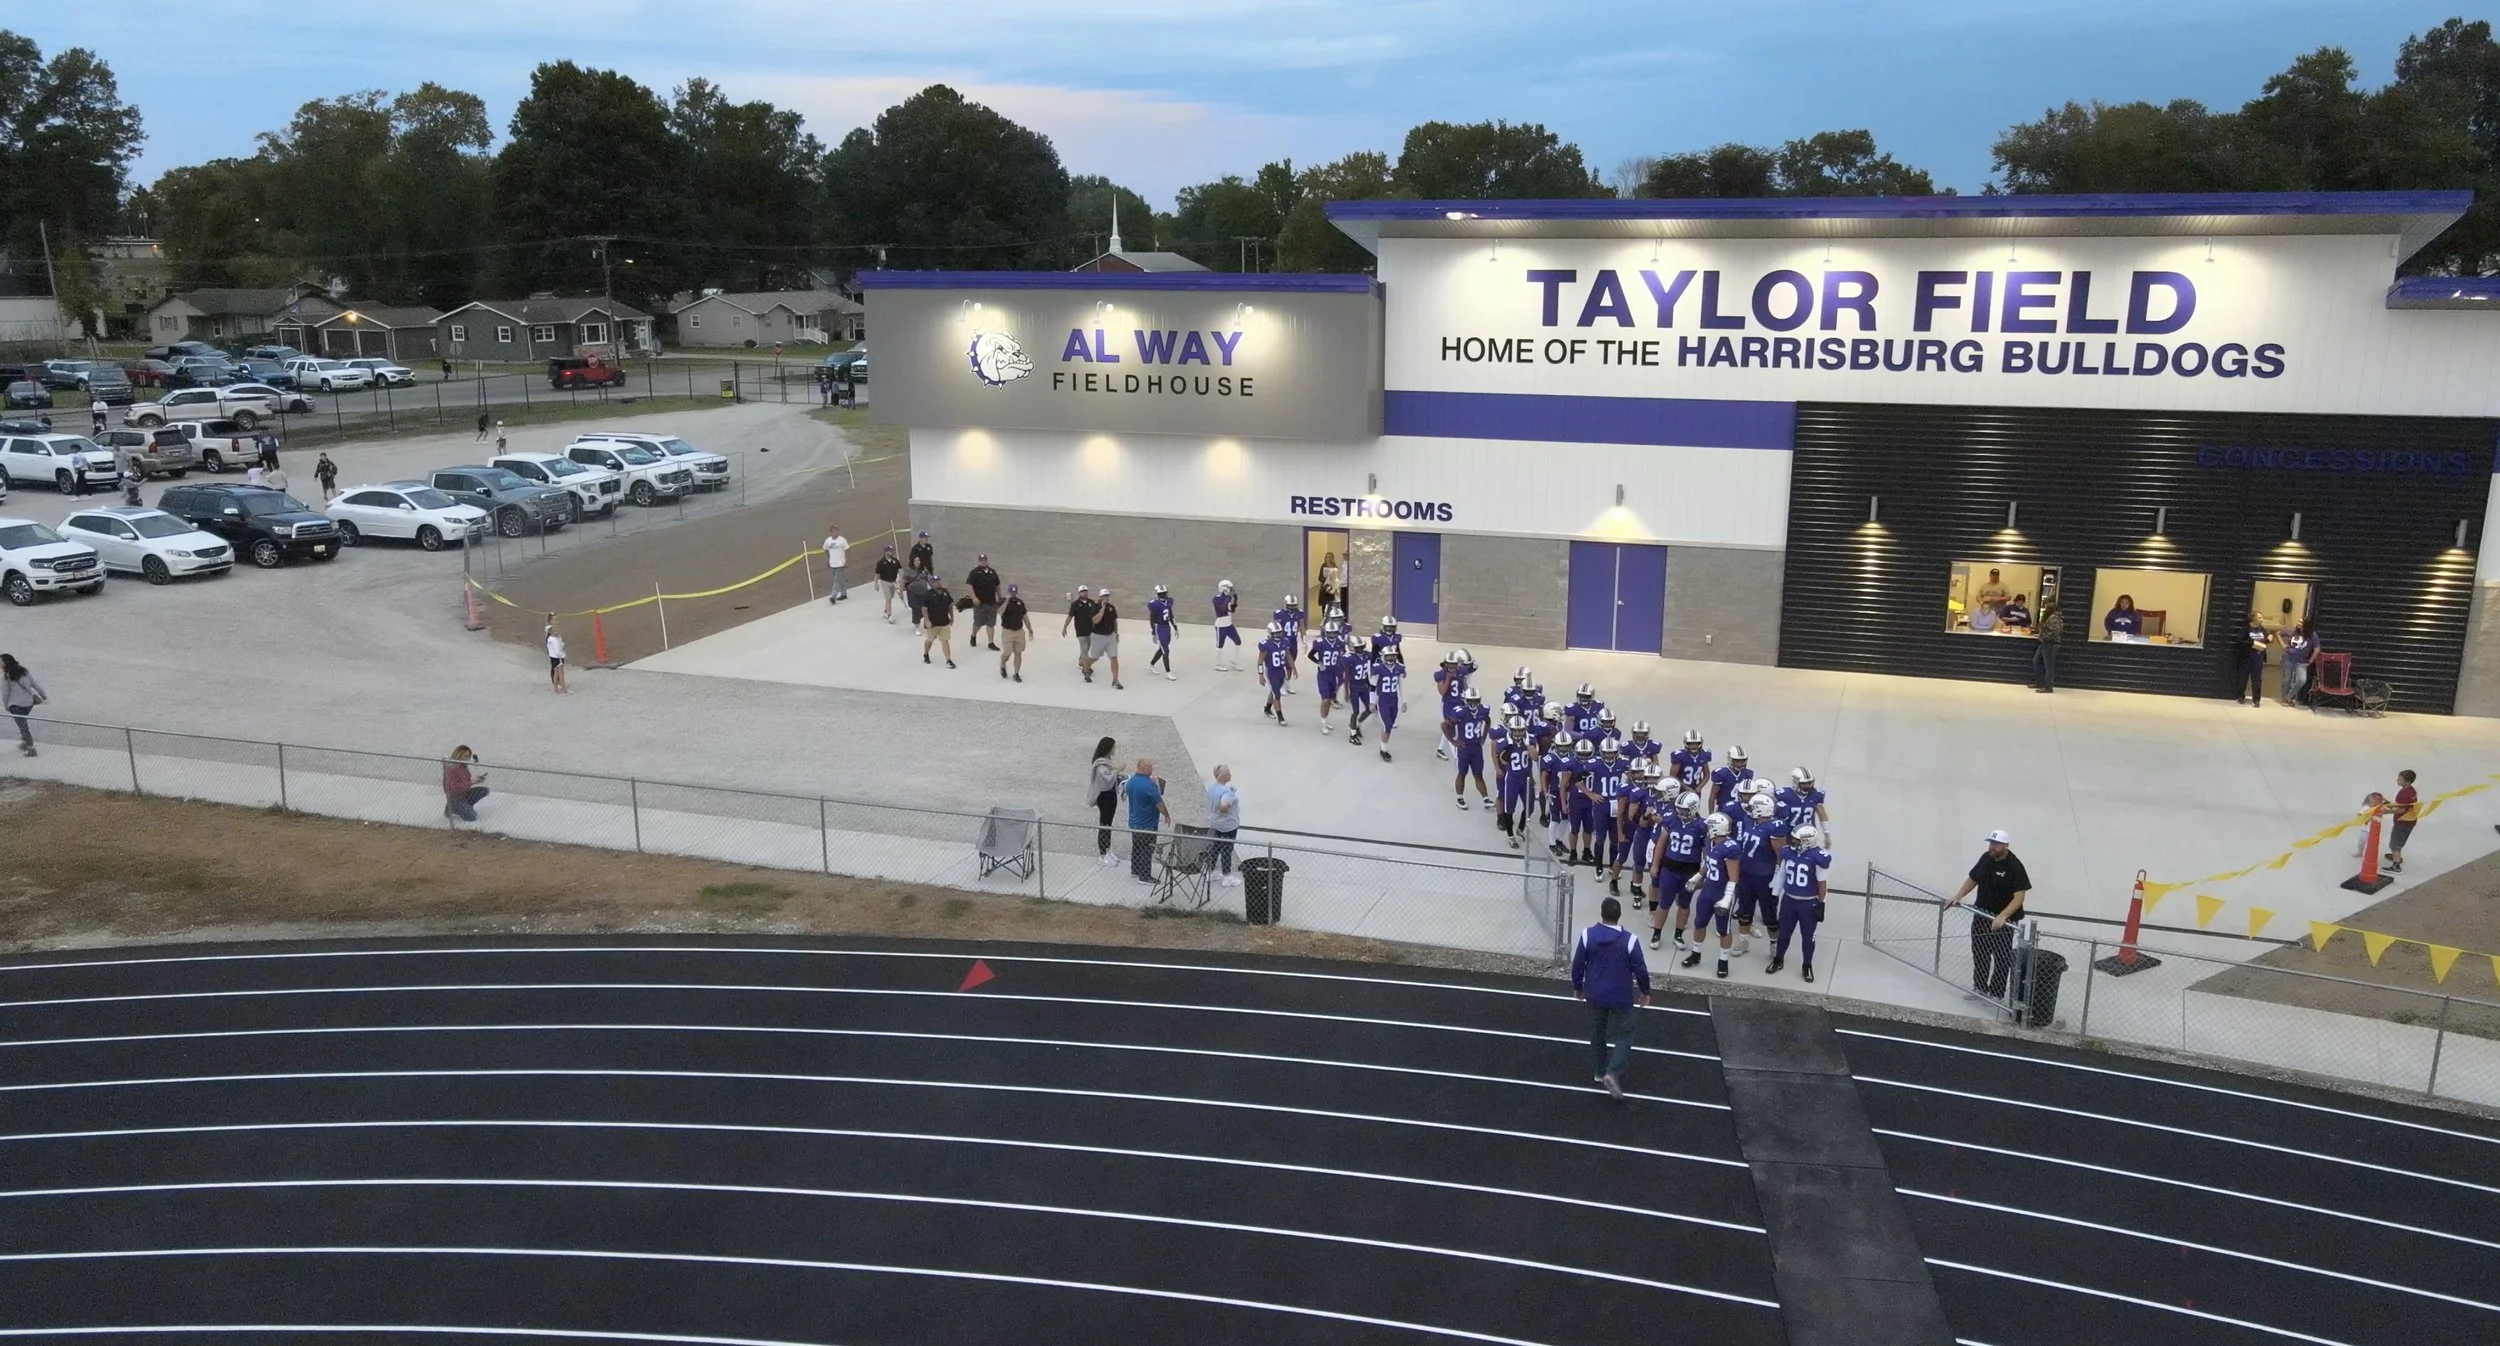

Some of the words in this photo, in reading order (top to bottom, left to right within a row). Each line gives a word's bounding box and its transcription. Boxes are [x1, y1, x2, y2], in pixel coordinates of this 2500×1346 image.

[1526, 269, 1879, 332] TAYLOR
[1913, 270, 2197, 334] FIELD
[1061, 328, 1120, 363] AL
[1134, 330, 1243, 366] WAY
[1441, 336, 1534, 364] HOME
[1544, 338, 1587, 365] OF
[1596, 339, 1660, 366] THE
[1678, 336, 1984, 373] HARRISBURG
[2001, 340, 2286, 379] BULLDOGS
[1053, 372, 1254, 397] FIELDHOUSE
[2197, 445, 2469, 474] CONCESSIONS
[1291, 495, 1453, 522] RESTROOMS
[1601, 776, 1619, 797] 10
